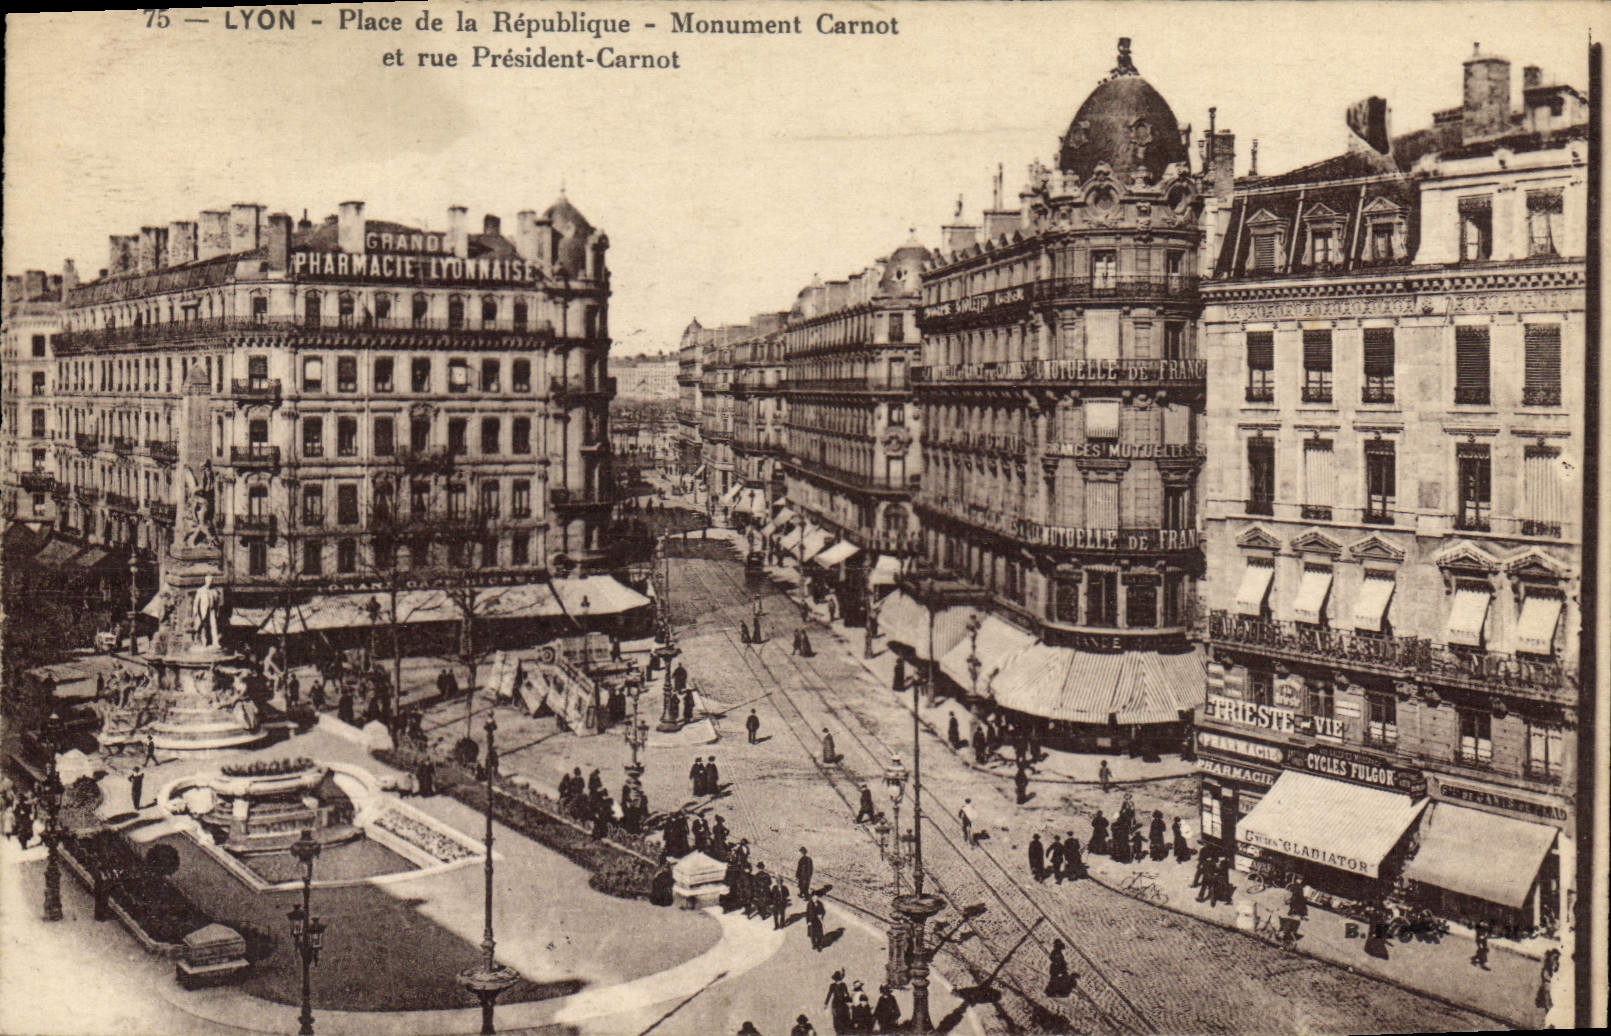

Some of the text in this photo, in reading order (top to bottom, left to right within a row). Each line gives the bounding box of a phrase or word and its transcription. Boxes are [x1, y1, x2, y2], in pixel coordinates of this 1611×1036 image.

[295, 251, 535, 281] PHARMACIE LYONNAISE
[1128, 366, 1149, 381] DE
[1128, 535, 1149, 551] DE
[1210, 697, 1295, 734] TRIESTE
[1313, 716, 1344, 738] VIE
[1197, 757, 1275, 785] PHARMACIE
[1306, 752, 1347, 777] CYCLES
[1351, 763, 1396, 786] FULGOR
